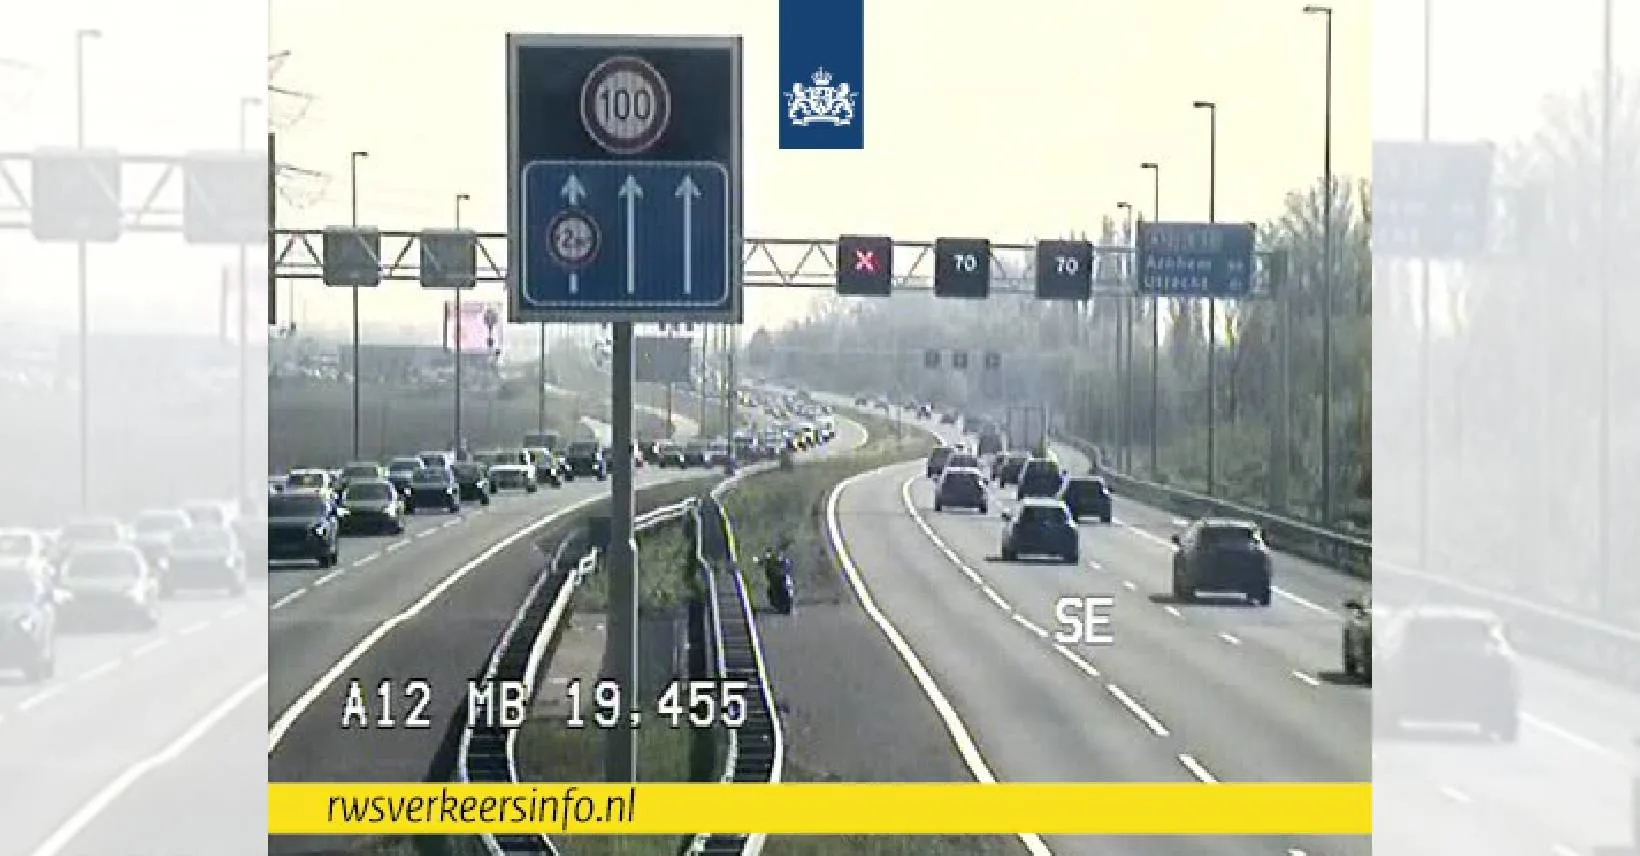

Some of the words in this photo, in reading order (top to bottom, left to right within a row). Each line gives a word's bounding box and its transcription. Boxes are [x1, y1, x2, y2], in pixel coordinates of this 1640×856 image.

[602, 88, 650, 121] 100
[954, 254, 978, 272] 70
[1056, 256, 1079, 275] 70
